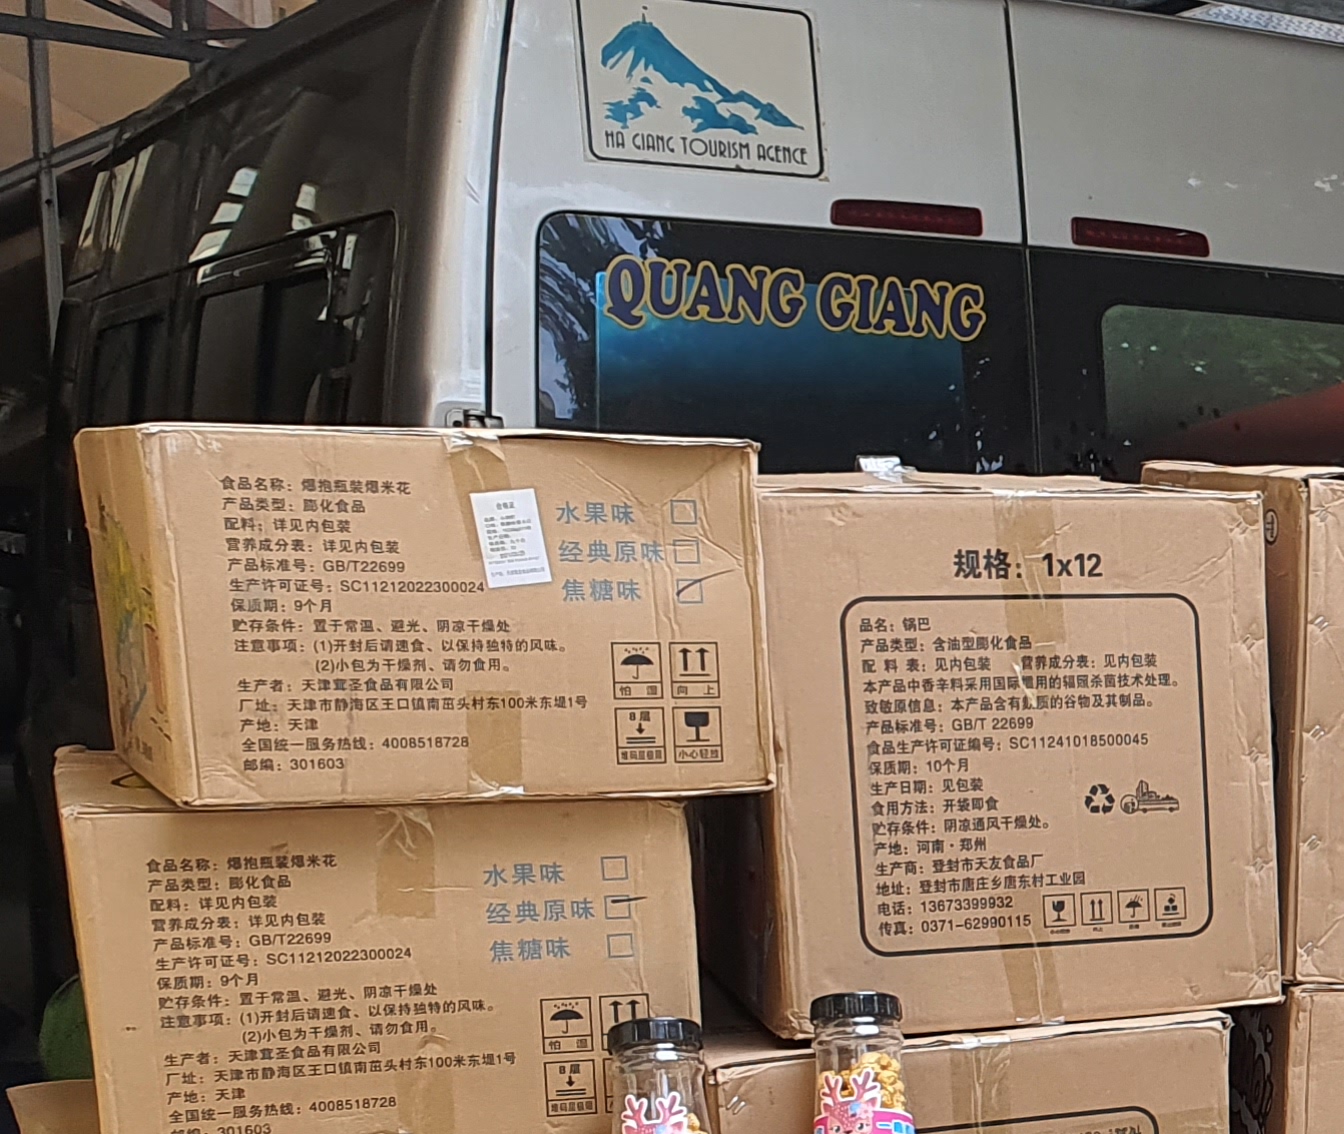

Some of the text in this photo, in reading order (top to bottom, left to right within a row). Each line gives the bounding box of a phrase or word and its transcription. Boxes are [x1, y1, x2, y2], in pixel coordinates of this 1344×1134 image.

[604, 130, 626, 150] HA
[680, 136, 751, 161] TOURISM
[757, 143, 809, 166] AGENCE
[604, 254, 987, 342] QUANG GIANG
[556, 501, 636, 525] 水果味
[558, 540, 666, 564] 经典原味
[562, 579, 642, 602] 焦糖味
[483, 863, 565, 887] 水果味
[486, 898, 596, 925] 经典原味
[490, 937, 571, 963] 焦糖味
